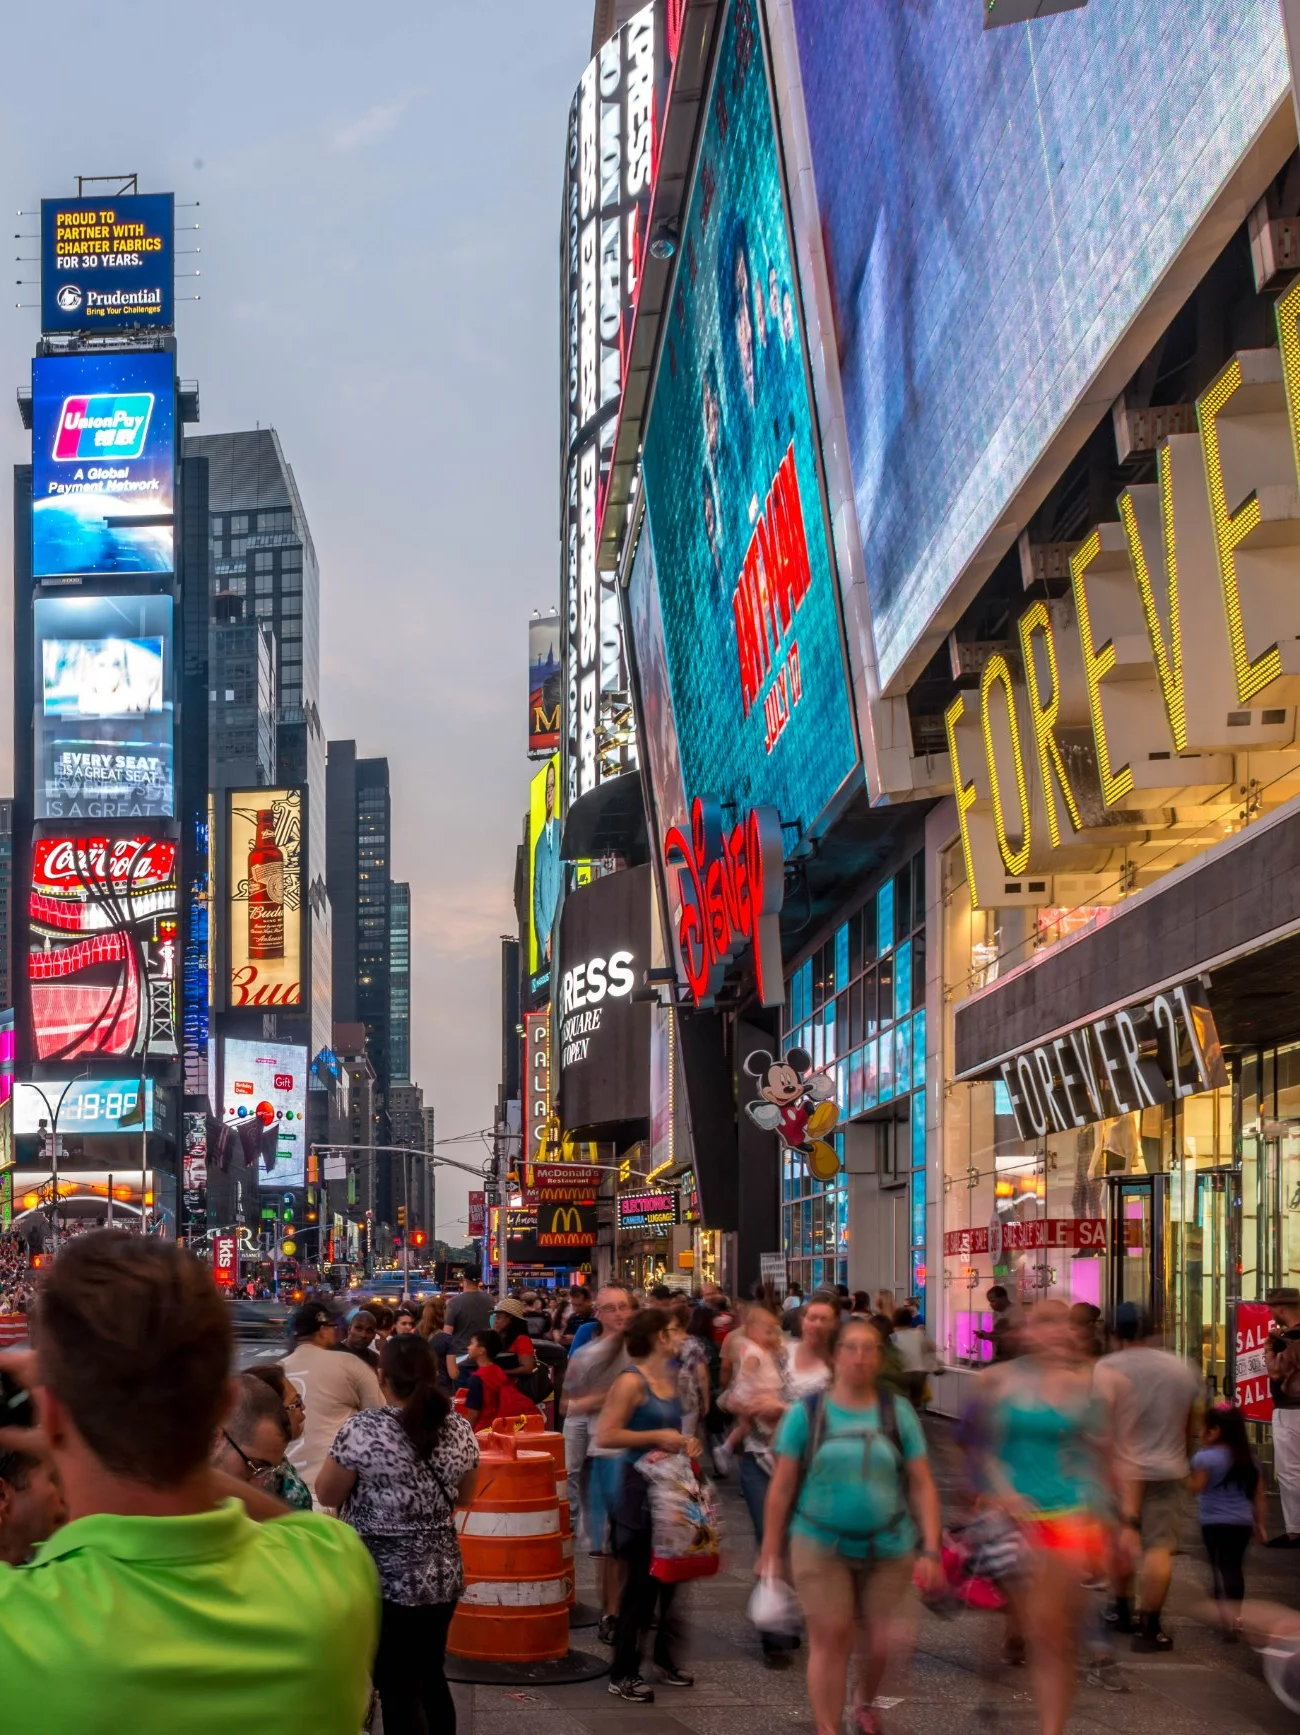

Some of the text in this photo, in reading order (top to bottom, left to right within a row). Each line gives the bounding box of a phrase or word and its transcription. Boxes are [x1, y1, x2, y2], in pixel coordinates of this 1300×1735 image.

[57, 212, 114, 226] PROUD TO
[57, 224, 144, 240] PARTNER WITH
[57, 238, 161, 254] CHARTER FABRICS
[57, 254, 143, 269] FOR 30 YEARS.
[87, 289, 161, 306] Prudential
[86, 305, 161, 316] Bring Your Challenges
[64, 410, 145, 430] UnionPay
[74, 467, 129, 480] A Global
[48, 479, 159, 496] Payment Network
[763, 660, 790, 756] JULY
[63, 752, 158, 770] EVERY SEAT
[63, 766, 158, 784] IS A GREAT SEAT
[665, 796, 765, 1006] Disney
[560, 950, 635, 1013] RESS
[1001, 985, 1212, 1142] FOREVER 21
[275, 1077, 291, 1088] Gift
[534, 1026, 548, 1141] PALAC
[537, 1169, 599, 1178] McDonald's
[621, 1197, 673, 1214] ELECTRONICS
[622, 1212, 674, 1225] CAMERA LUGGAGE
[975, 1229, 988, 1250] SALE
[1003, 1225, 1017, 1248] SALE
[1019, 1224, 1032, 1246] SALE
[1079, 1221, 1131, 1246] SAE
[218, 1238, 231, 1268] tkts
